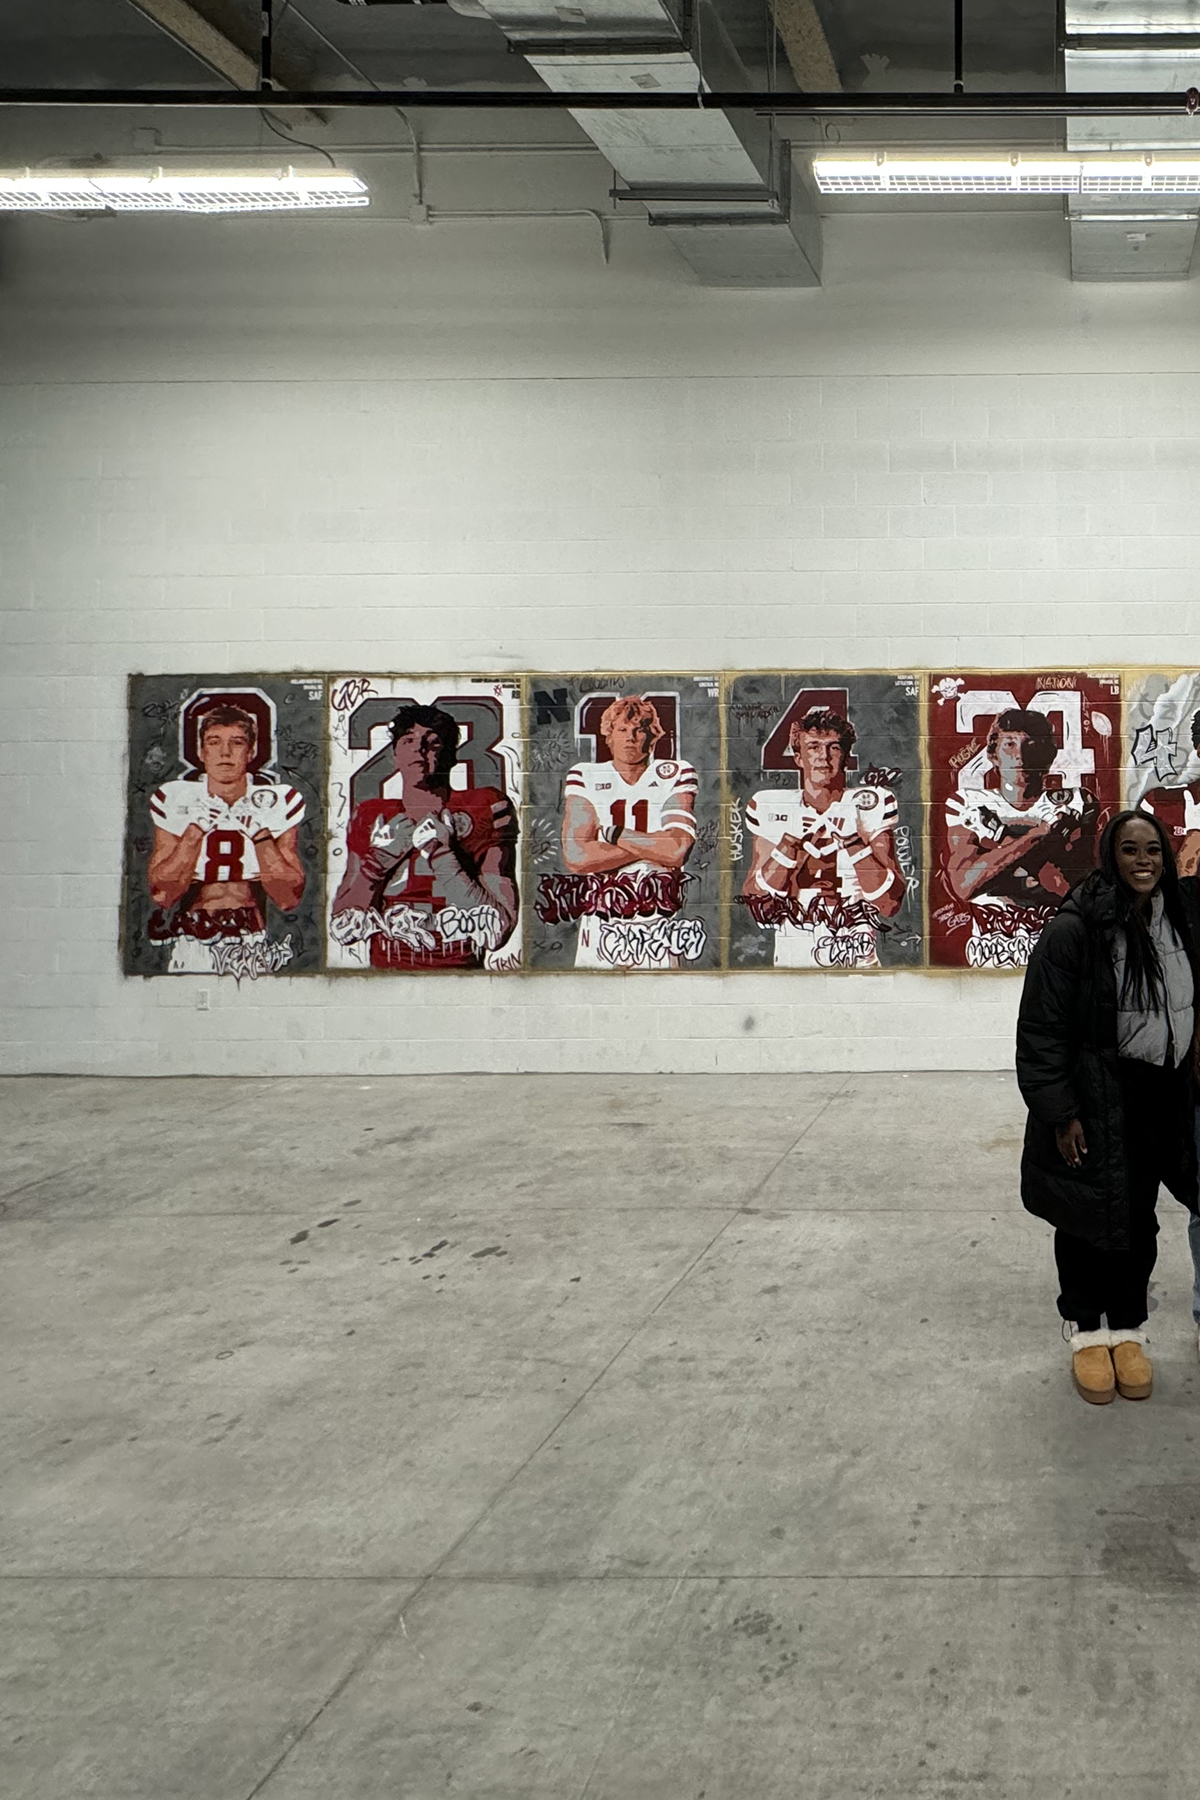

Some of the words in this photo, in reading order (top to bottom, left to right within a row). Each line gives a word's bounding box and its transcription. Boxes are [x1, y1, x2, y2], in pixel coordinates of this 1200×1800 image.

[308, 691, 323, 701] SAF
[331, 678, 378, 711] GBR
[534, 688, 571, 725] N
[707, 688, 720, 698] WR
[905, 686, 920, 697] SAF
[1110, 685, 1120, 695] LB
[1131, 723, 1178, 782] 4
[610, 799, 649, 834] 11
[729, 797, 743, 861] HUSKER
[893, 826, 920, 912] POWER
[581, 930, 590, 947] N
